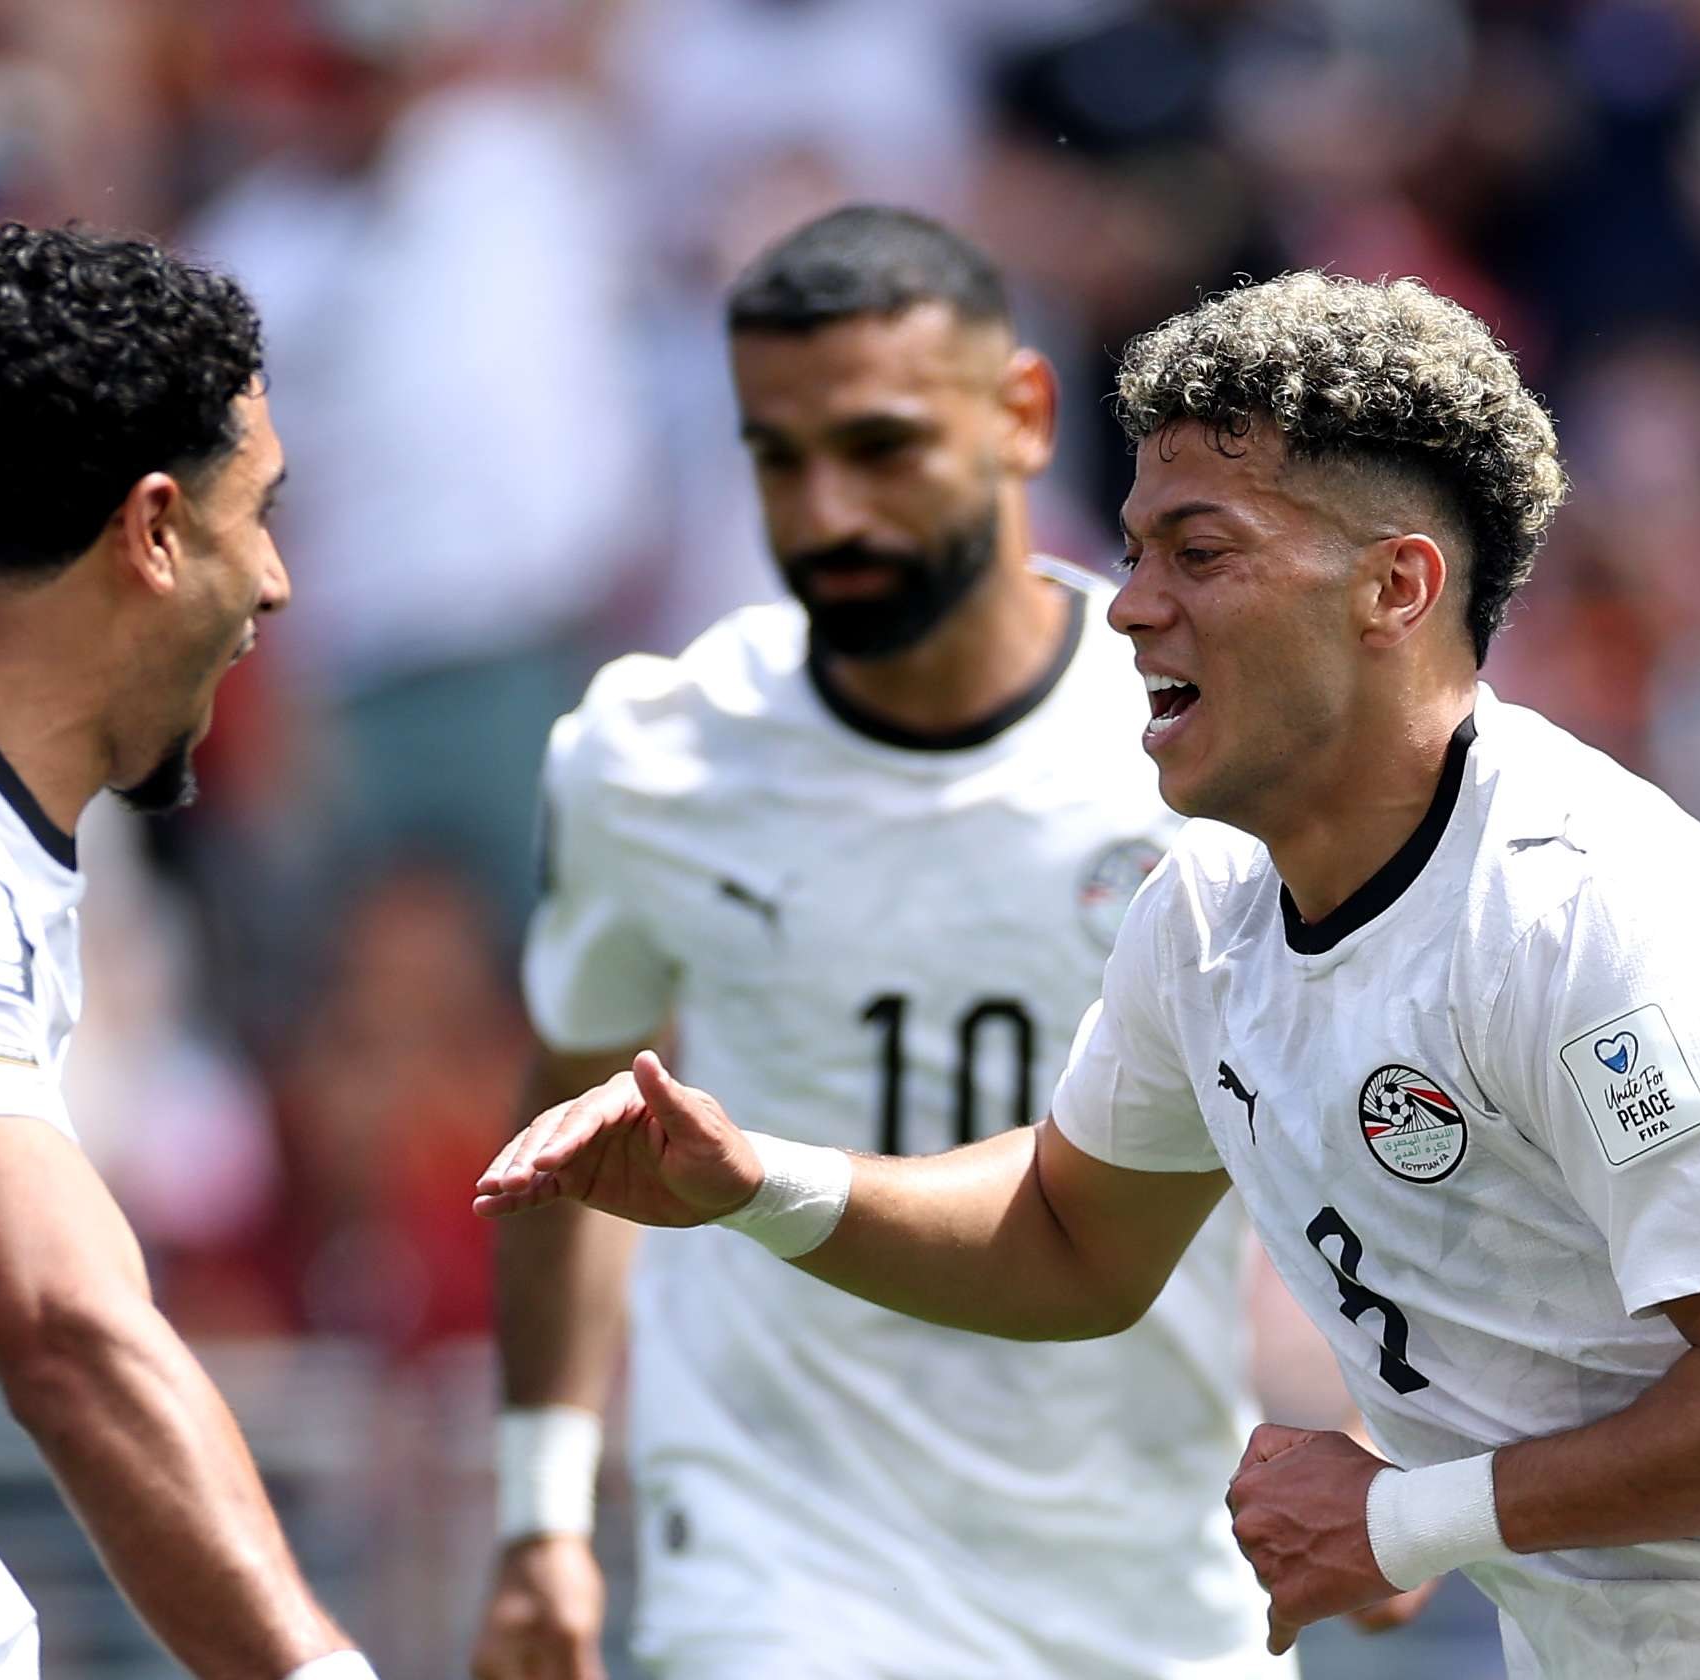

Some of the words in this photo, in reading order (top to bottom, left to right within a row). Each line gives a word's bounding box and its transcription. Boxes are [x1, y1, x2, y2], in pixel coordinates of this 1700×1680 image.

[860, 991, 1036, 1156] 10
[1604, 1078, 1643, 1110] Unite
[1639, 1065, 1664, 1092] For
[1616, 1088, 1676, 1132] PEACE
[1638, 1120, 1671, 1142] FIFA
[1401, 1160, 1440, 1171] EGYPTIAN
[1438, 1152, 1450, 1163] FA
[1306, 1206, 1430, 1395] 8
